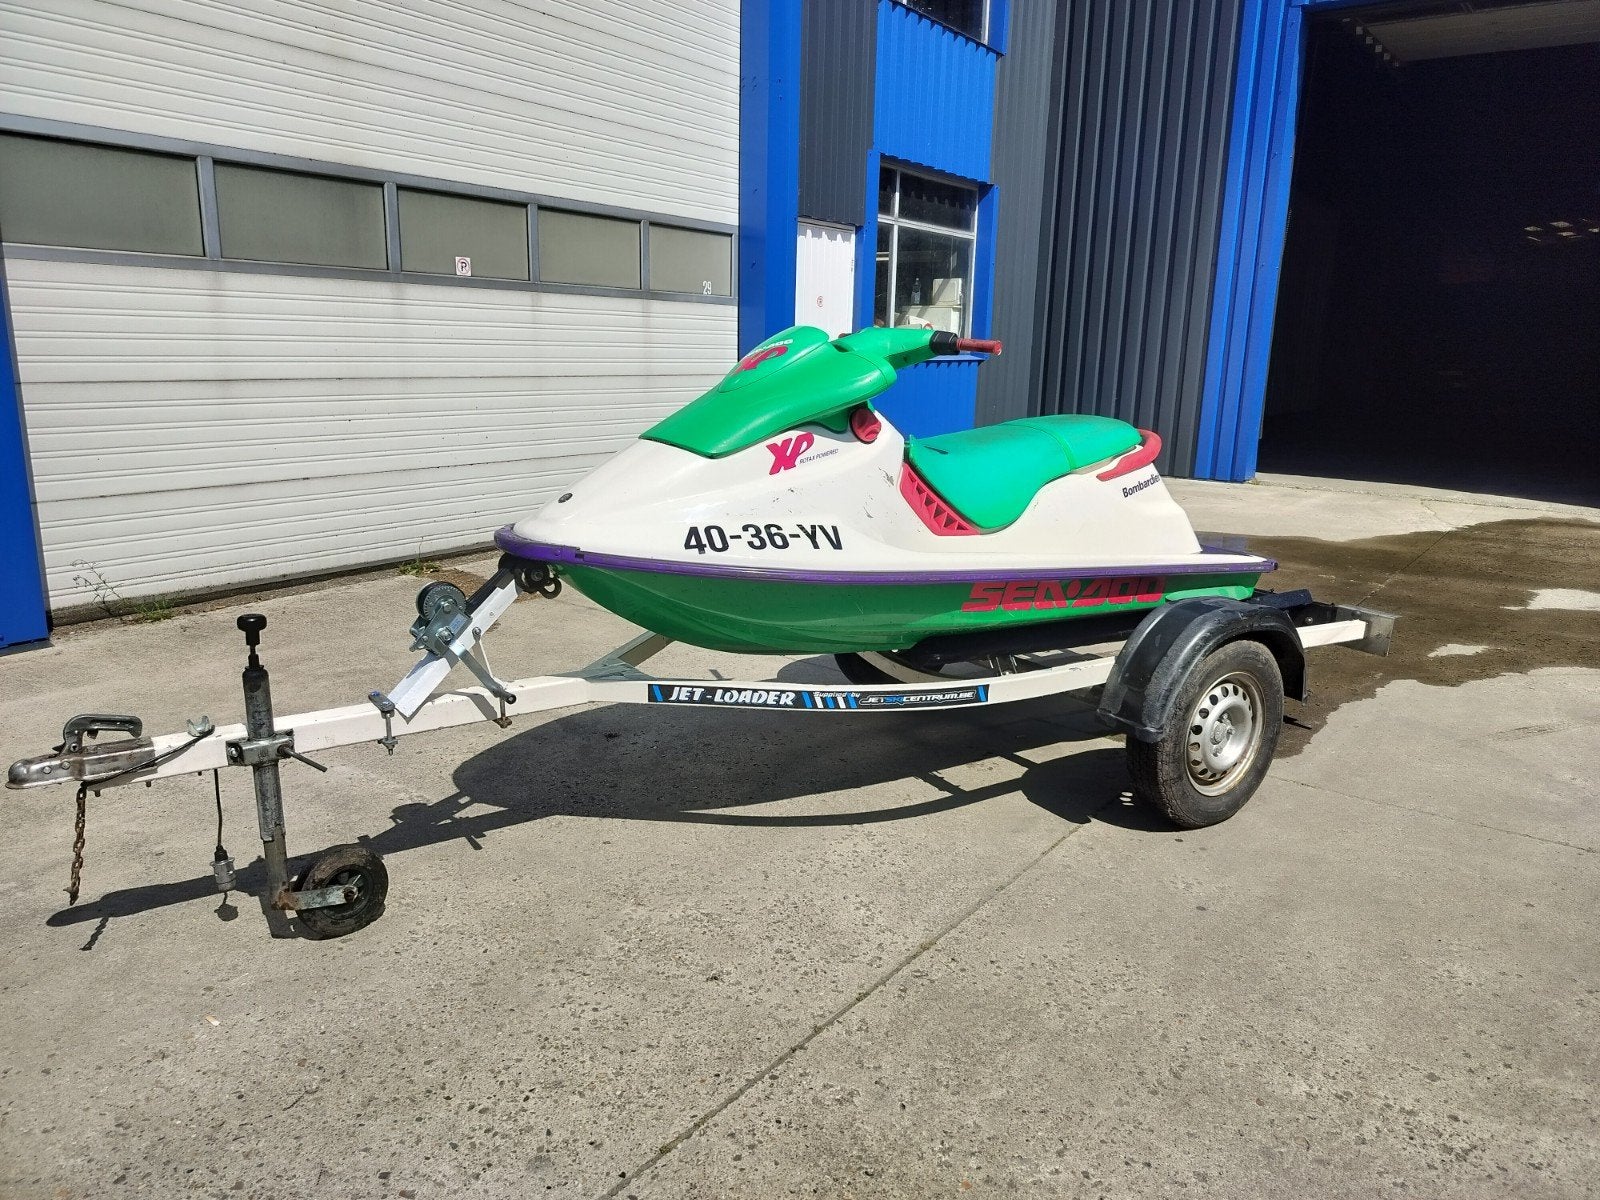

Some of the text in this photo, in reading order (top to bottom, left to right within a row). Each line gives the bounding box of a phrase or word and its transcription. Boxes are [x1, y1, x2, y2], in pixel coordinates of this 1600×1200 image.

[702, 280, 712, 295] 29
[765, 432, 815, 476] XP
[683, 523, 843, 555] 40-36-YV
[812, 691, 848, 699] Supplied
